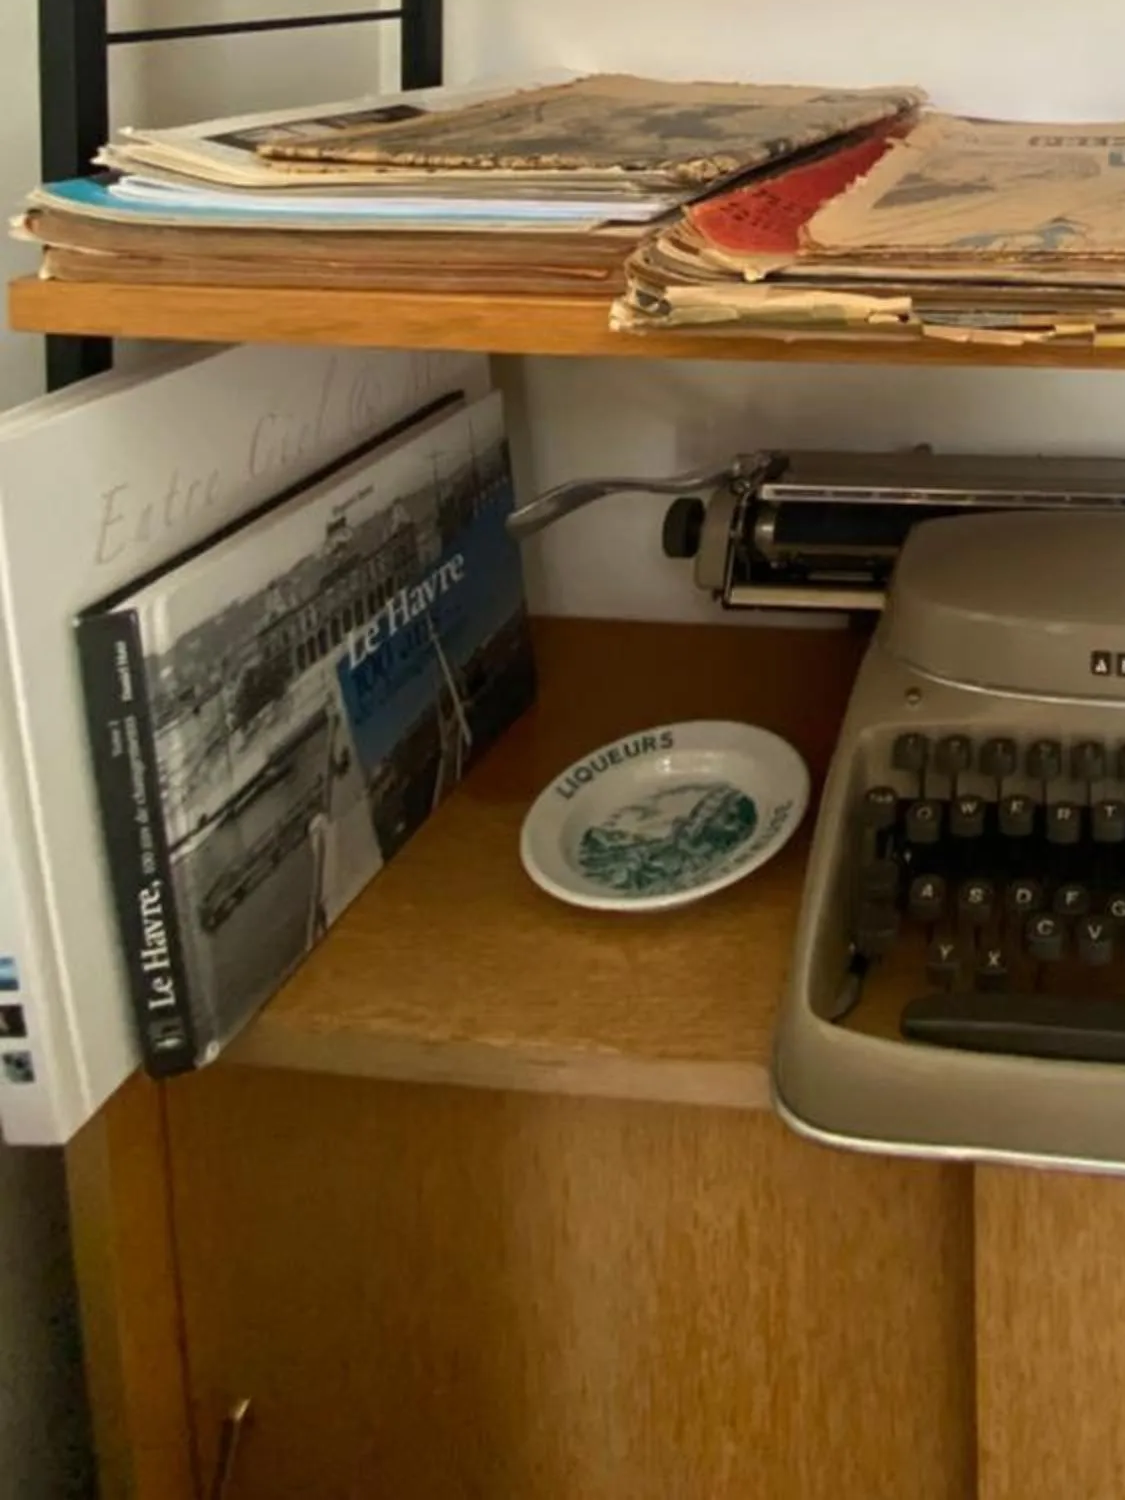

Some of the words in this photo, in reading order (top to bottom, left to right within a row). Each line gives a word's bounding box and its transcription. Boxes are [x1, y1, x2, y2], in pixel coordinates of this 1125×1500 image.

[346, 626, 381, 671] Le
[385, 552, 465, 638] Havre
[556, 731, 674, 801] LIQUEURS
[139, 880, 171, 972] Havre,
[147, 975, 177, 1010] Le
